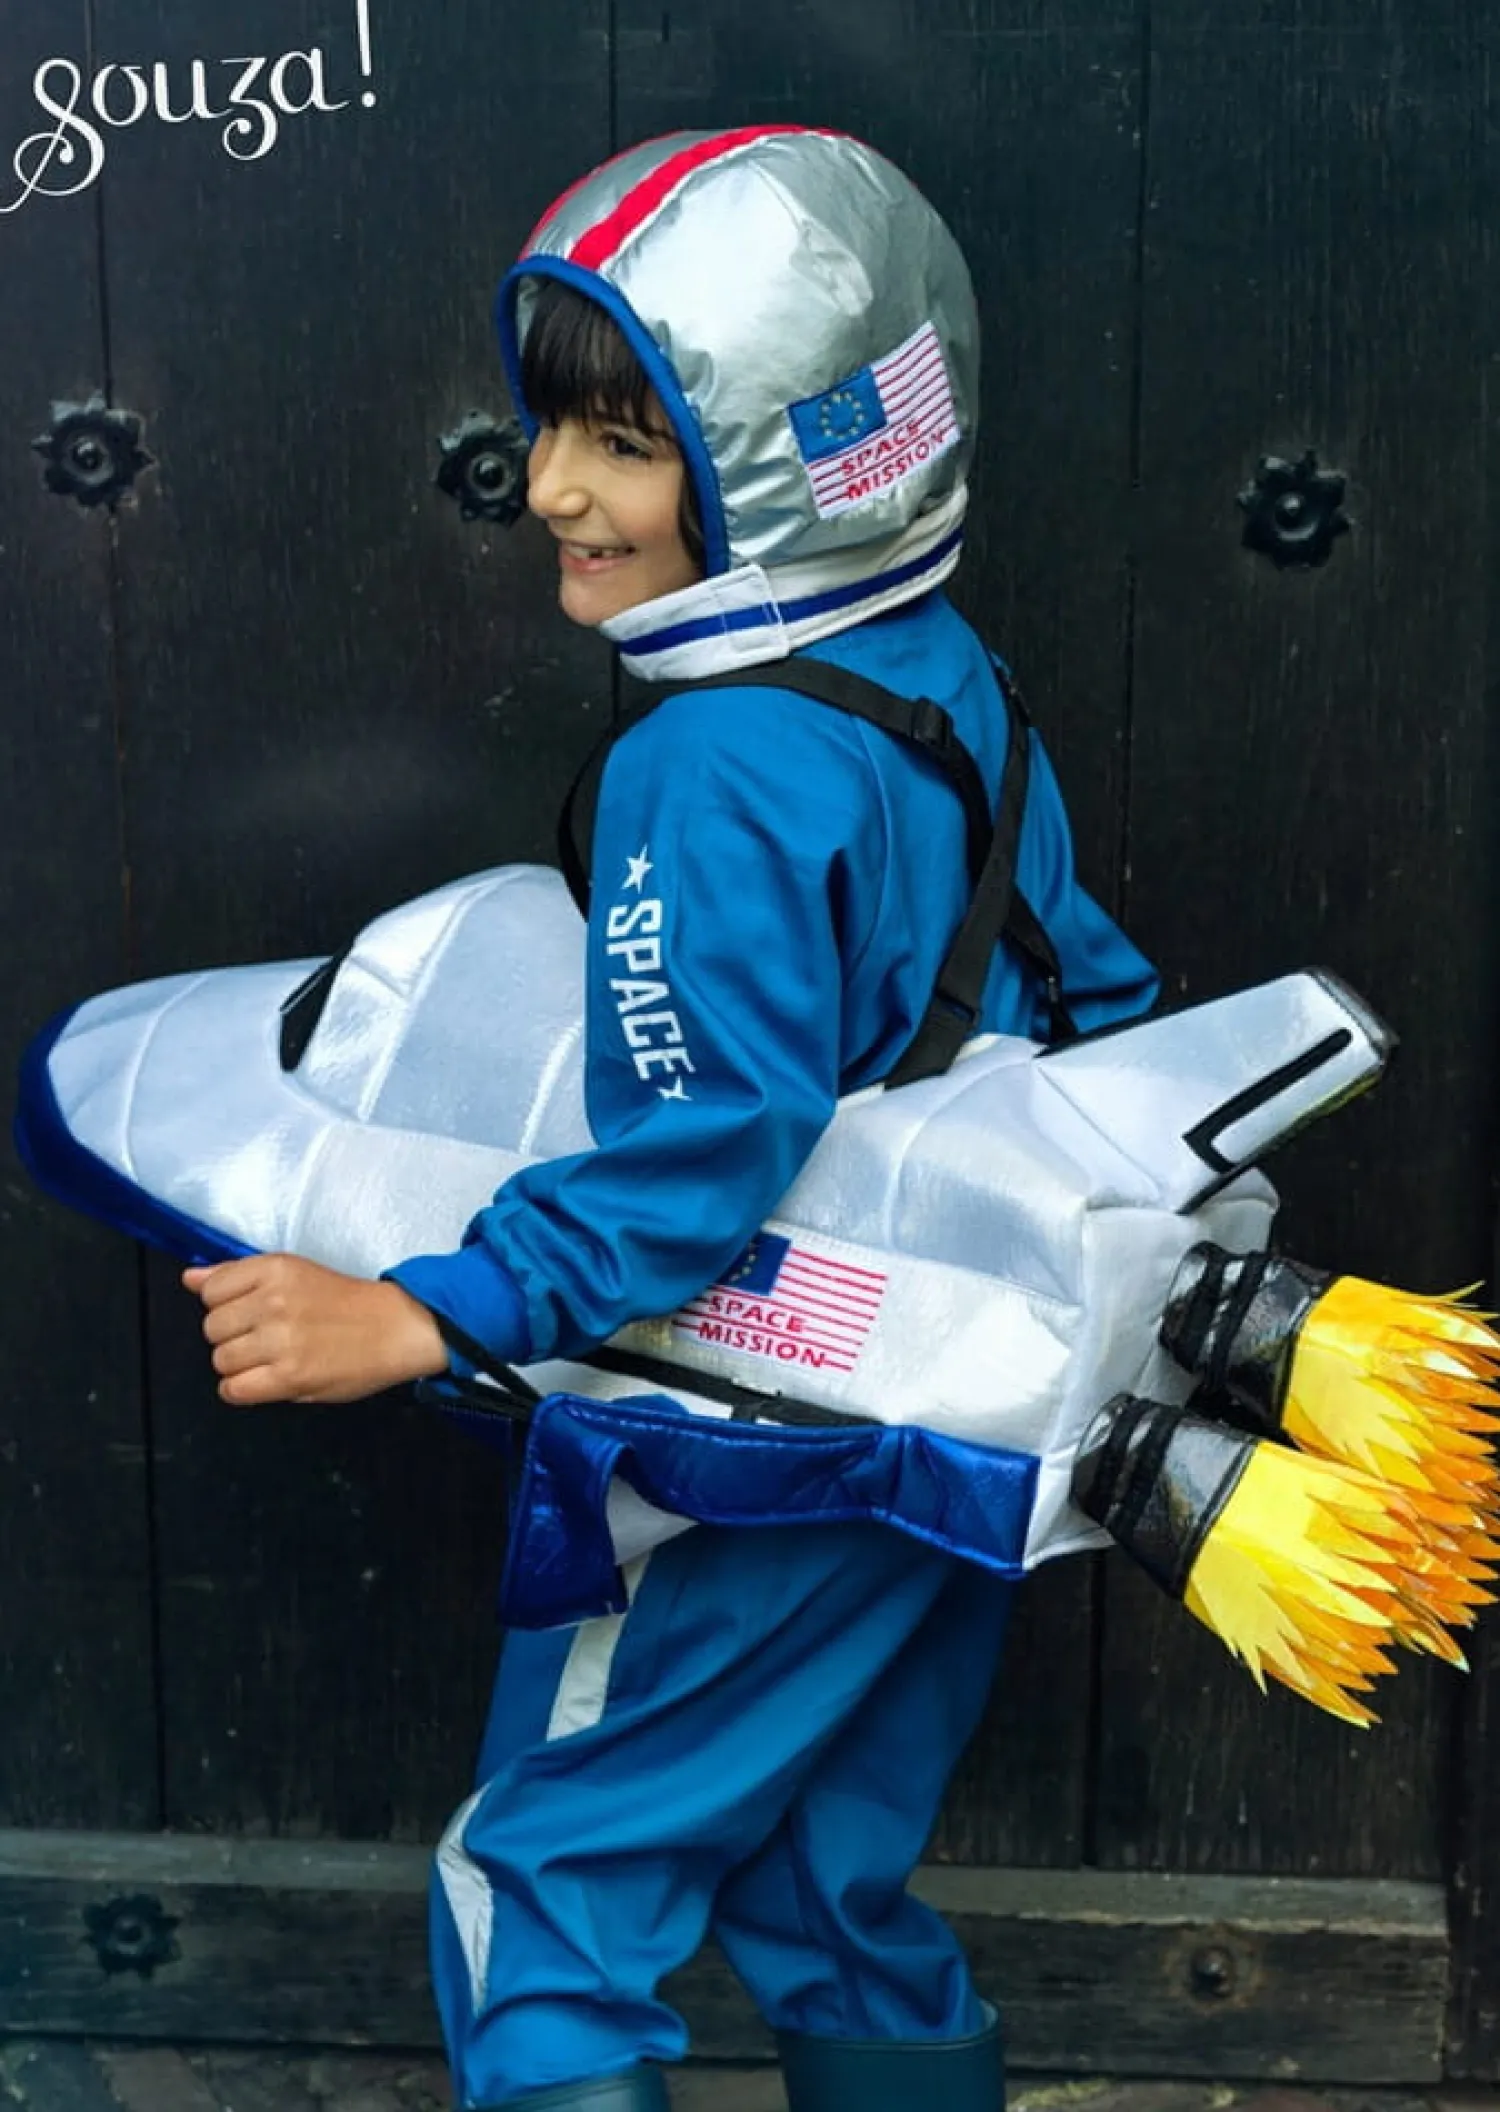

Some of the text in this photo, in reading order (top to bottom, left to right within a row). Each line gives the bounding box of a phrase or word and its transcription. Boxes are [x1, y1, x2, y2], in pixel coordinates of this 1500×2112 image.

[841, 422, 920, 476] SPACE
[847, 430, 945, 500] MISSION
[606, 898, 697, 1081] SPACE
[708, 1295, 807, 1333] SPACE
[699, 1322, 826, 1368] MISSION
